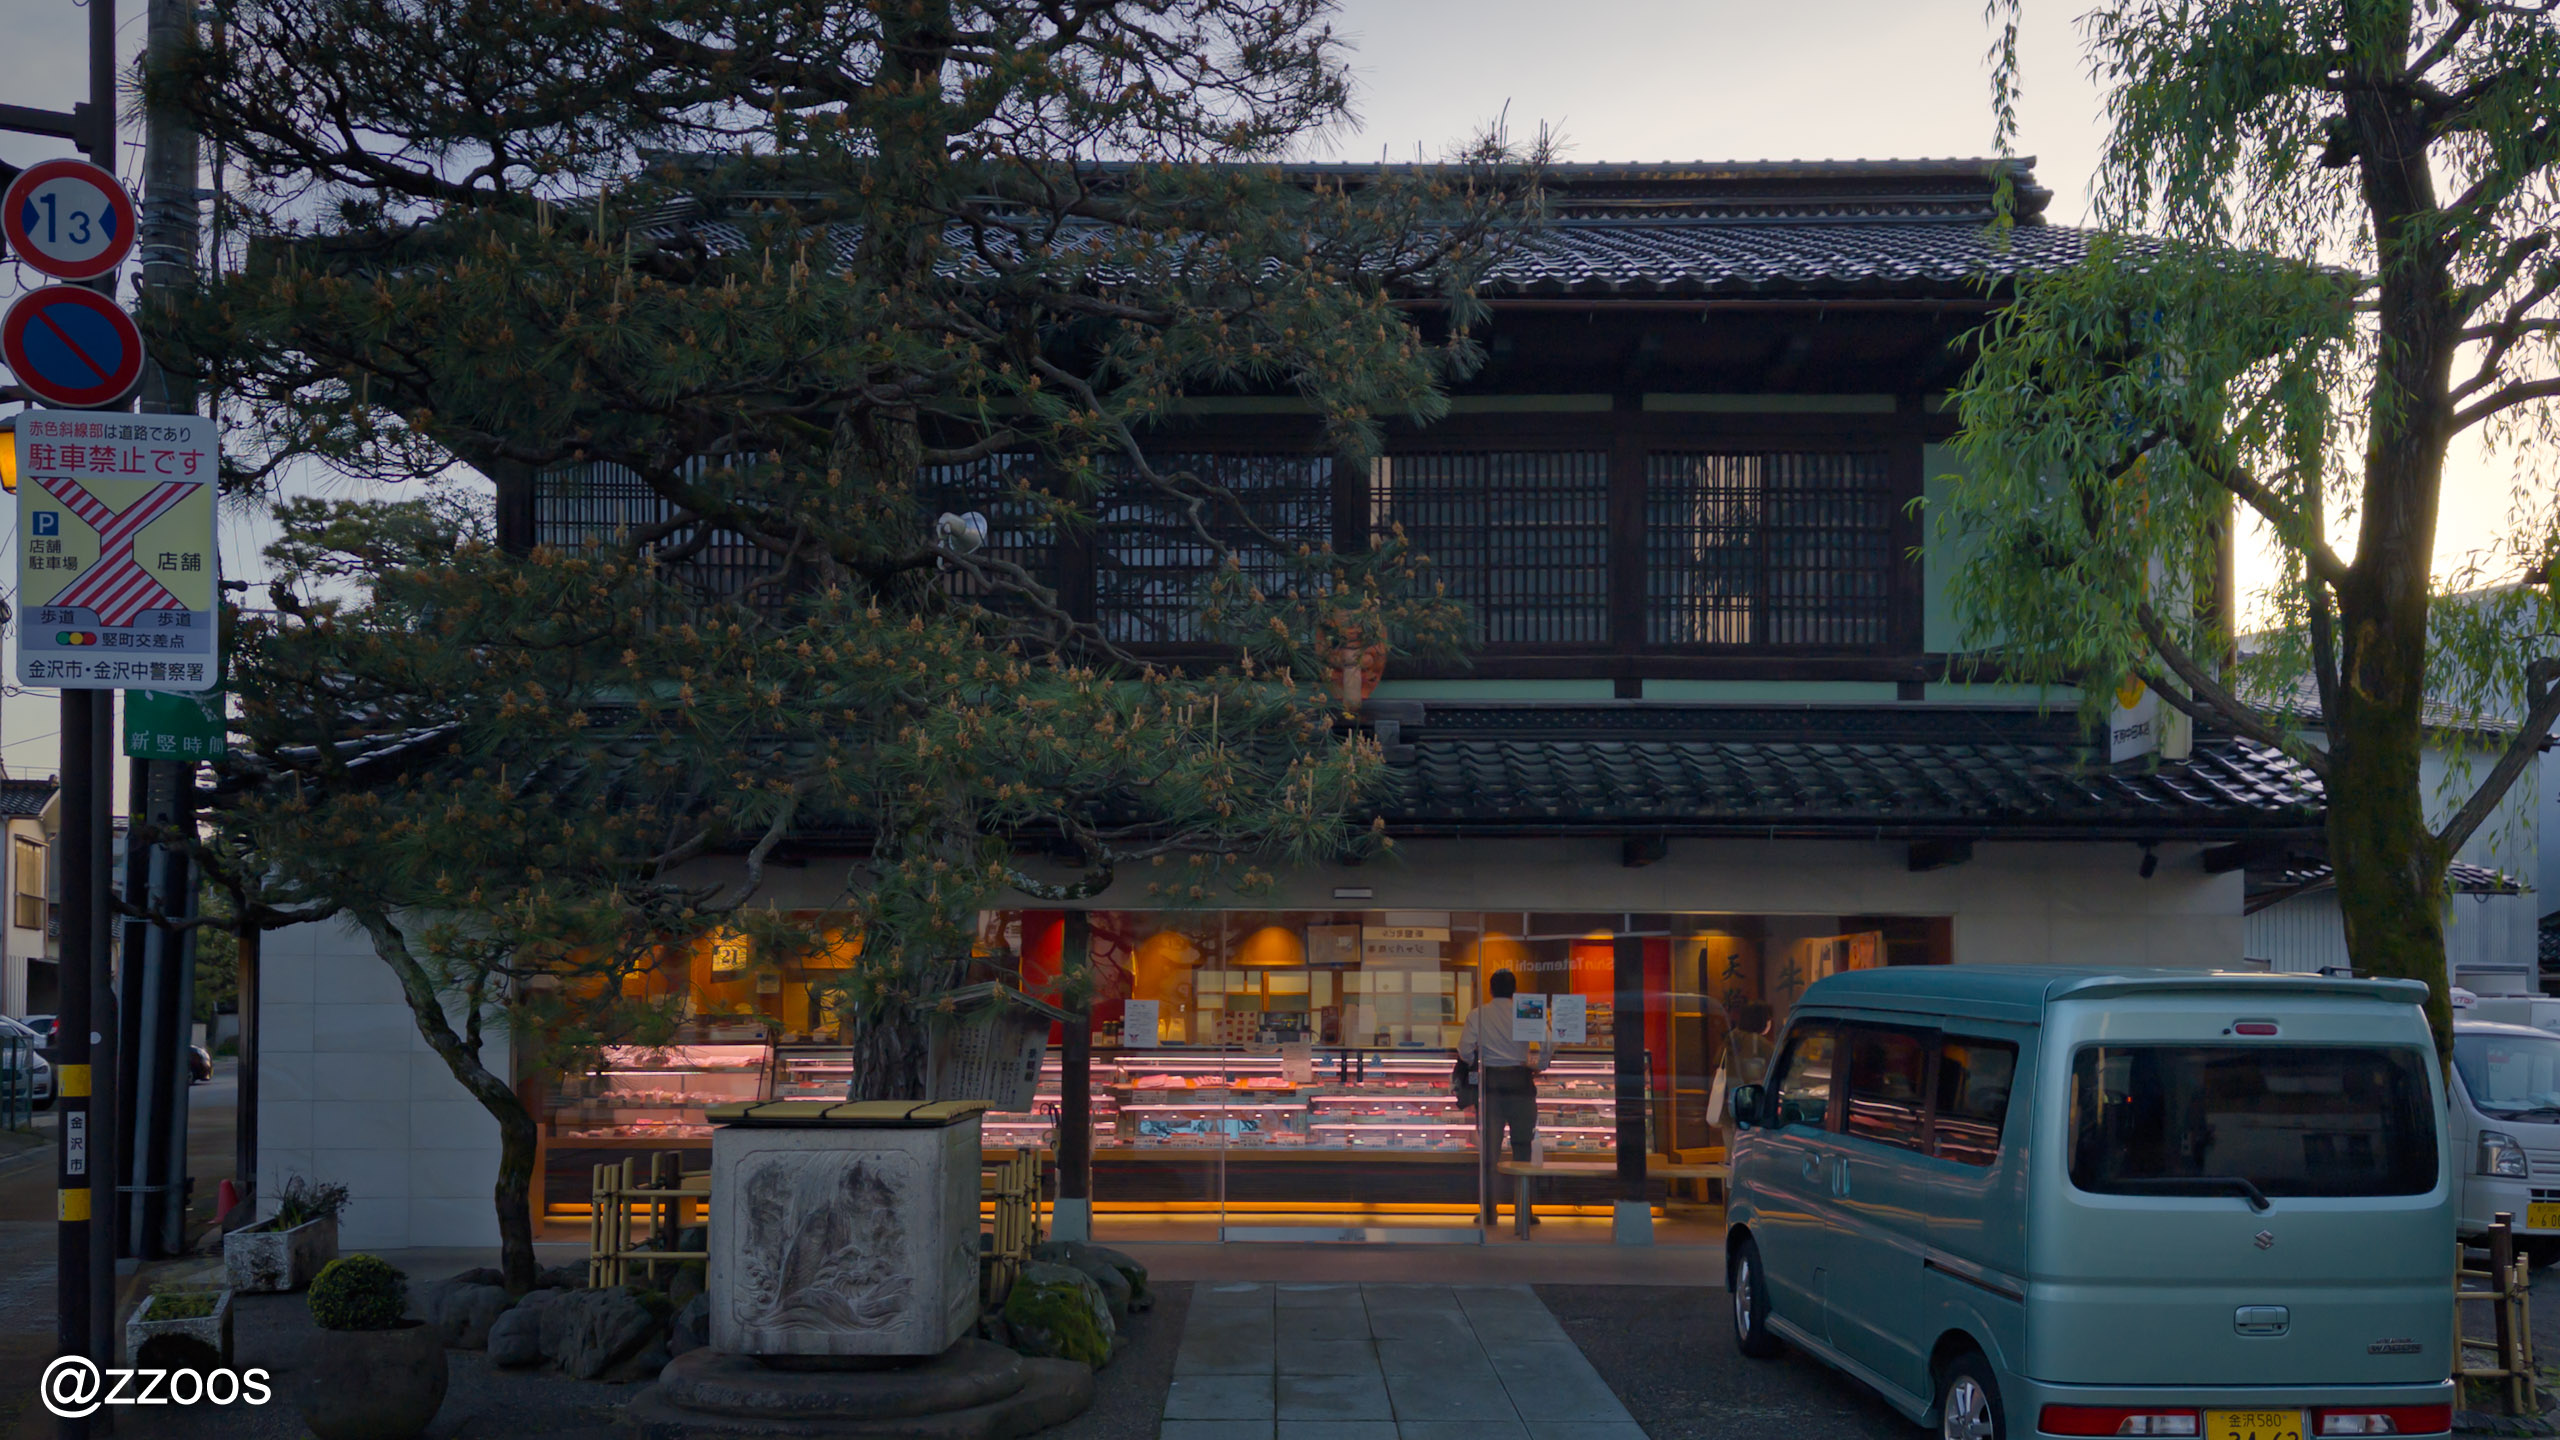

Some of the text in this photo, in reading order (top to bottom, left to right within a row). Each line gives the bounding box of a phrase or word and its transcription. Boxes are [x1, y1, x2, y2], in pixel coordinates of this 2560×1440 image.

[29, 420, 192, 443] 赤色斜線部は道路であり
[28, 443, 206, 476] 駐車禁止です
[38, 513, 55, 534] P
[29, 539, 62, 554] 店舗
[28, 556, 78, 571] 駐車場
[157, 552, 202, 572] 店舗
[40, 609, 75, 625] 歩道
[157, 612, 192, 628] 歩道
[102, 632, 185, 649] 竪町交差点
[28, 659, 204, 682] 金沢市・金沢中警察署
[70, 1115, 83, 1172] 金沢市
[2228, 1413, 2282, 1428] 金沢580
